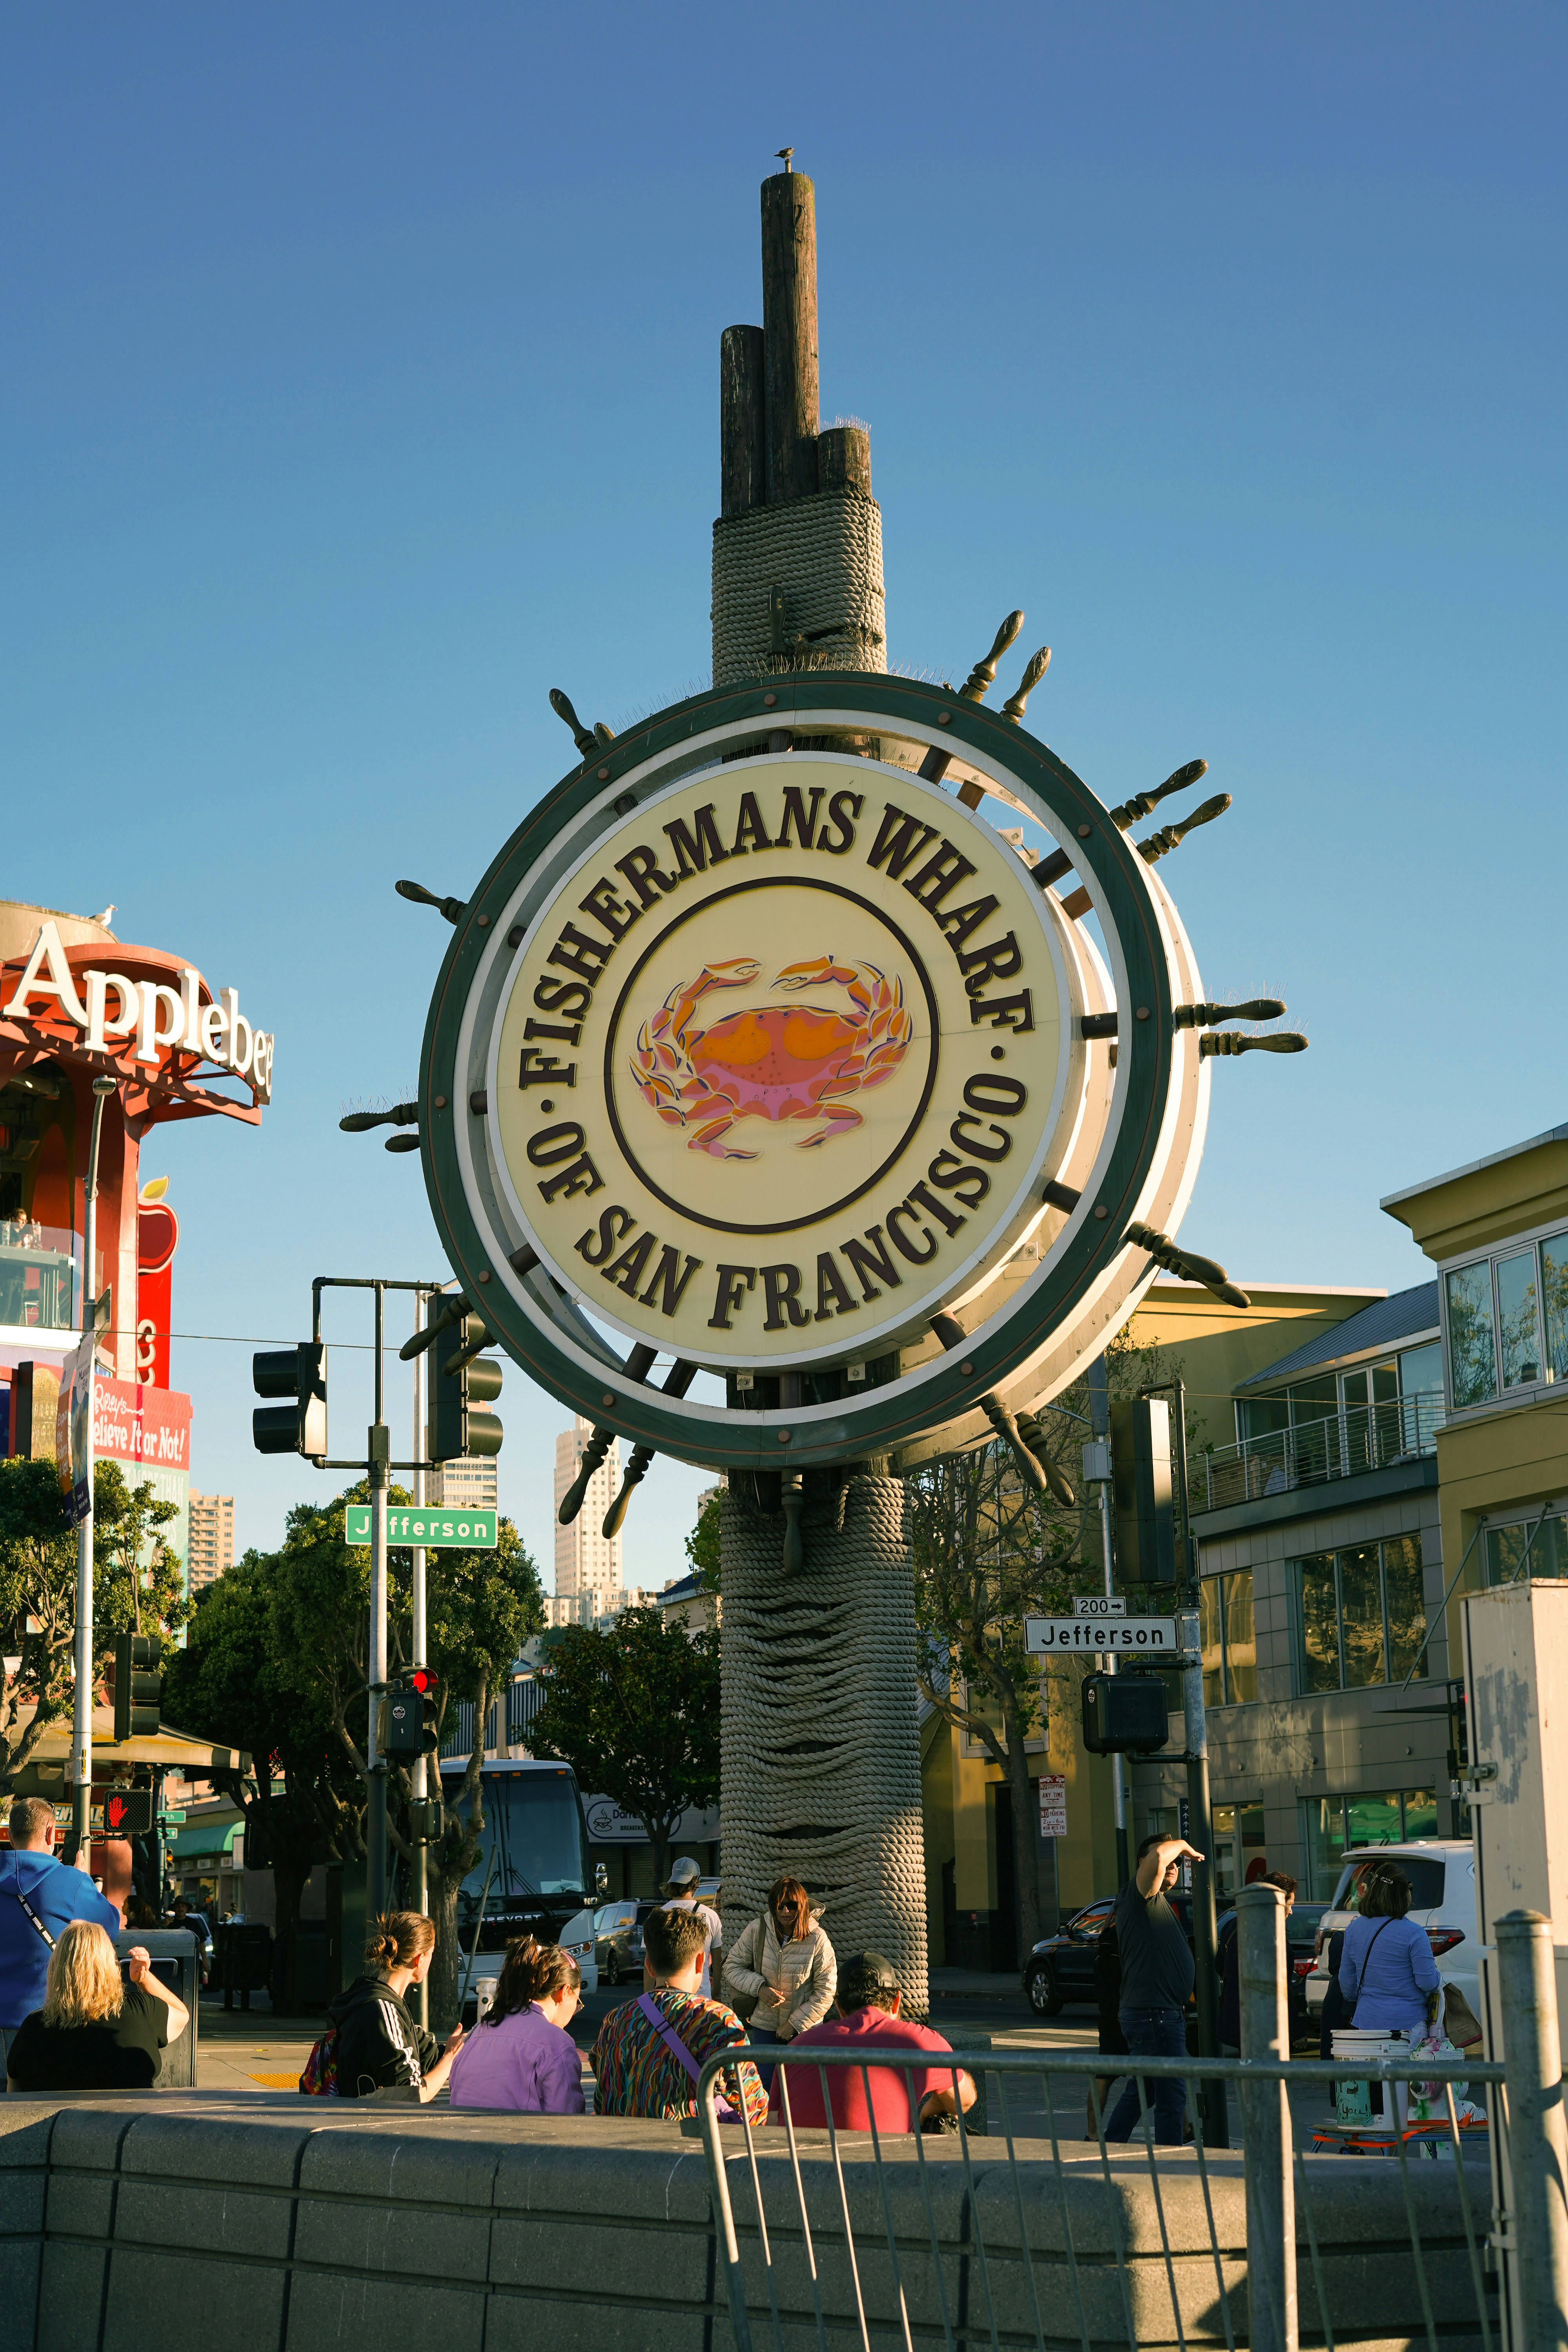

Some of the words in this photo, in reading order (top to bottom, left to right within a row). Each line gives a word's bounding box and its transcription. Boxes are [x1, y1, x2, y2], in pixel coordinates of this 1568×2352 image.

[519, 786, 866, 1090] FISHERMANS
[867, 802, 1035, 1034] WHARF
[1, 920, 274, 1096] Applebee'
[527, 1122, 605, 1204] OF
[573, 1205, 703, 1318] SAN
[708, 1074, 1028, 1331] FRANCISCO
[95, 1384, 127, 1423] Ripley's
[94, 1414, 127, 1450] elieve
[130, 1420, 142, 1453] It
[143, 1432, 157, 1455] or
[158, 1426, 184, 1462] Not!
[355, 1516, 486, 1537] Jfferson
[1080, 1600, 1108, 1613] 200
[1041, 1625, 1163, 1645] Jefferson
[32, 1916, 44, 1930] PUMA
